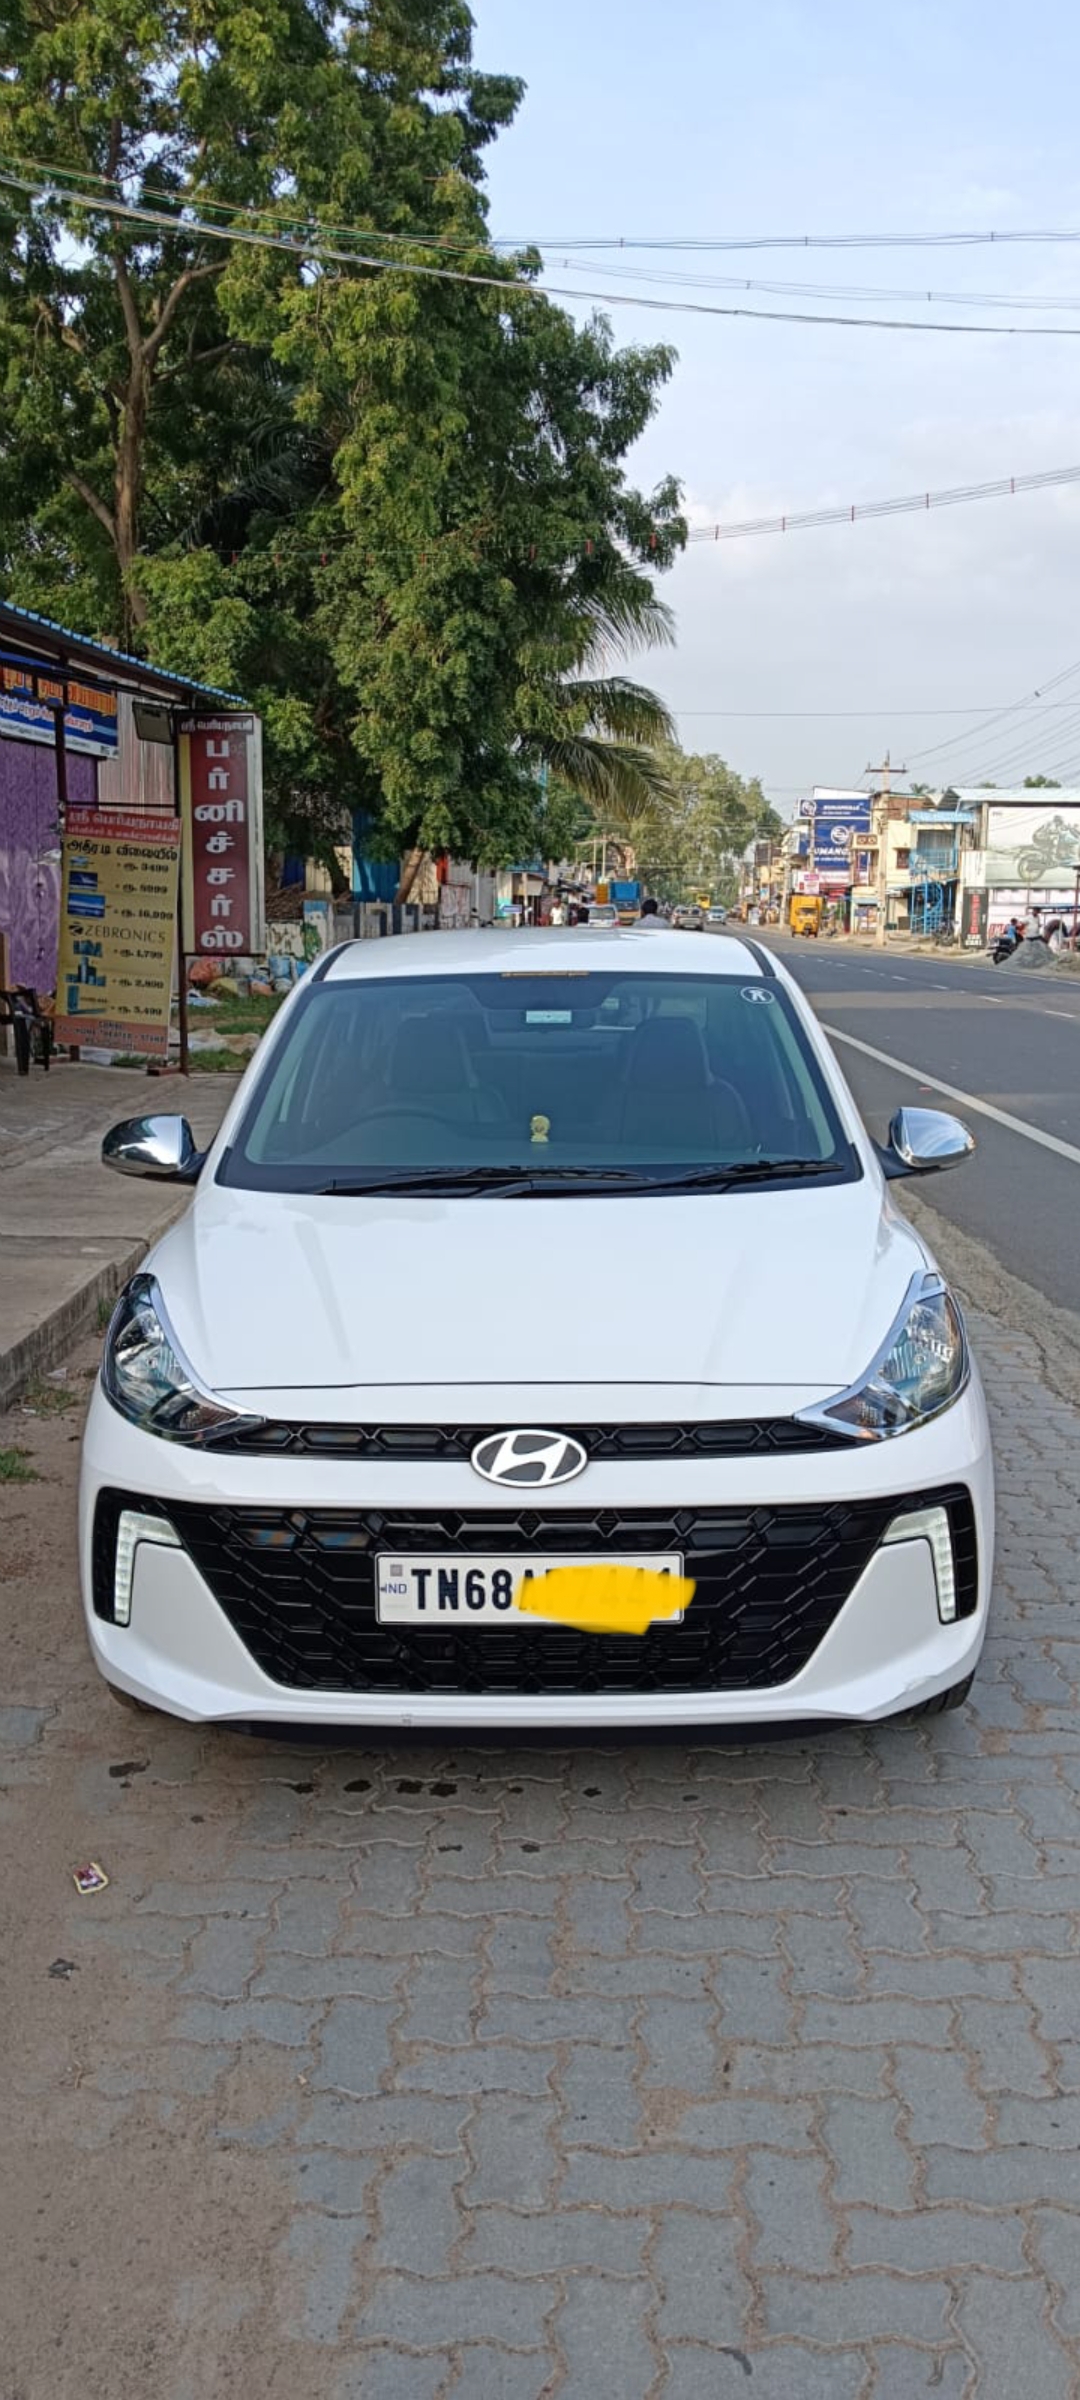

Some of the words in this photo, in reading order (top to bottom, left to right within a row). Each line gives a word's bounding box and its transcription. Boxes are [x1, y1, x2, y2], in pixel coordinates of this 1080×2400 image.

[116, 844, 178, 862] விலையில்
[85, 925, 166, 944] ZEBRONICS
[385, 1583, 407, 1594] IND
